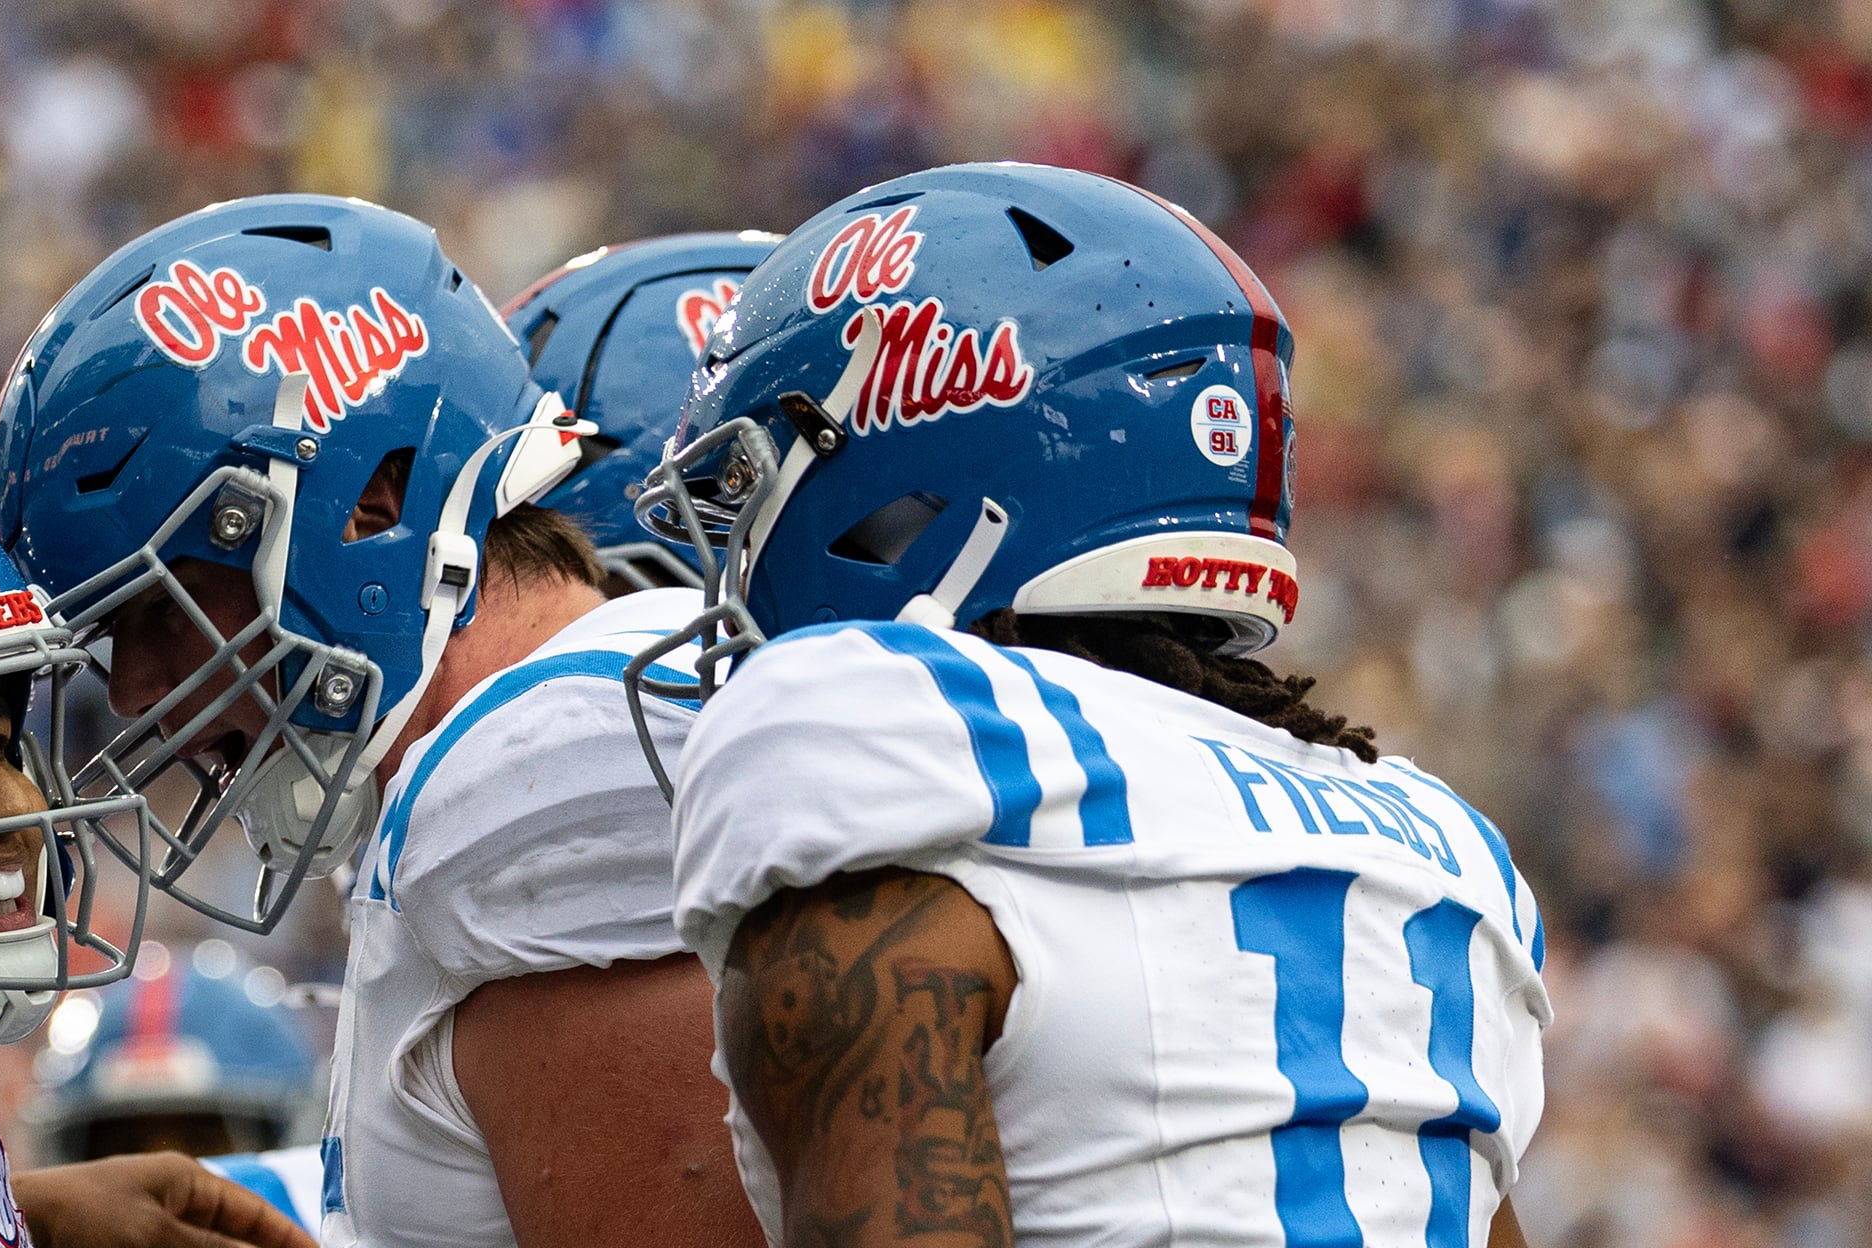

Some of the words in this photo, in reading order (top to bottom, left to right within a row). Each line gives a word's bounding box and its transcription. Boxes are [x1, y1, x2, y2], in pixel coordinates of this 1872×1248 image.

[807, 204, 925, 314] Ole
[135, 259, 266, 370] Ole
[242, 286, 429, 434] Miss
[841, 297, 1034, 437] Miss
[1207, 396, 1240, 422] CA
[1210, 429, 1238, 456] 91
[1142, 556, 1268, 594] HOTTY
[1187, 735, 1461, 877] FIELDS
